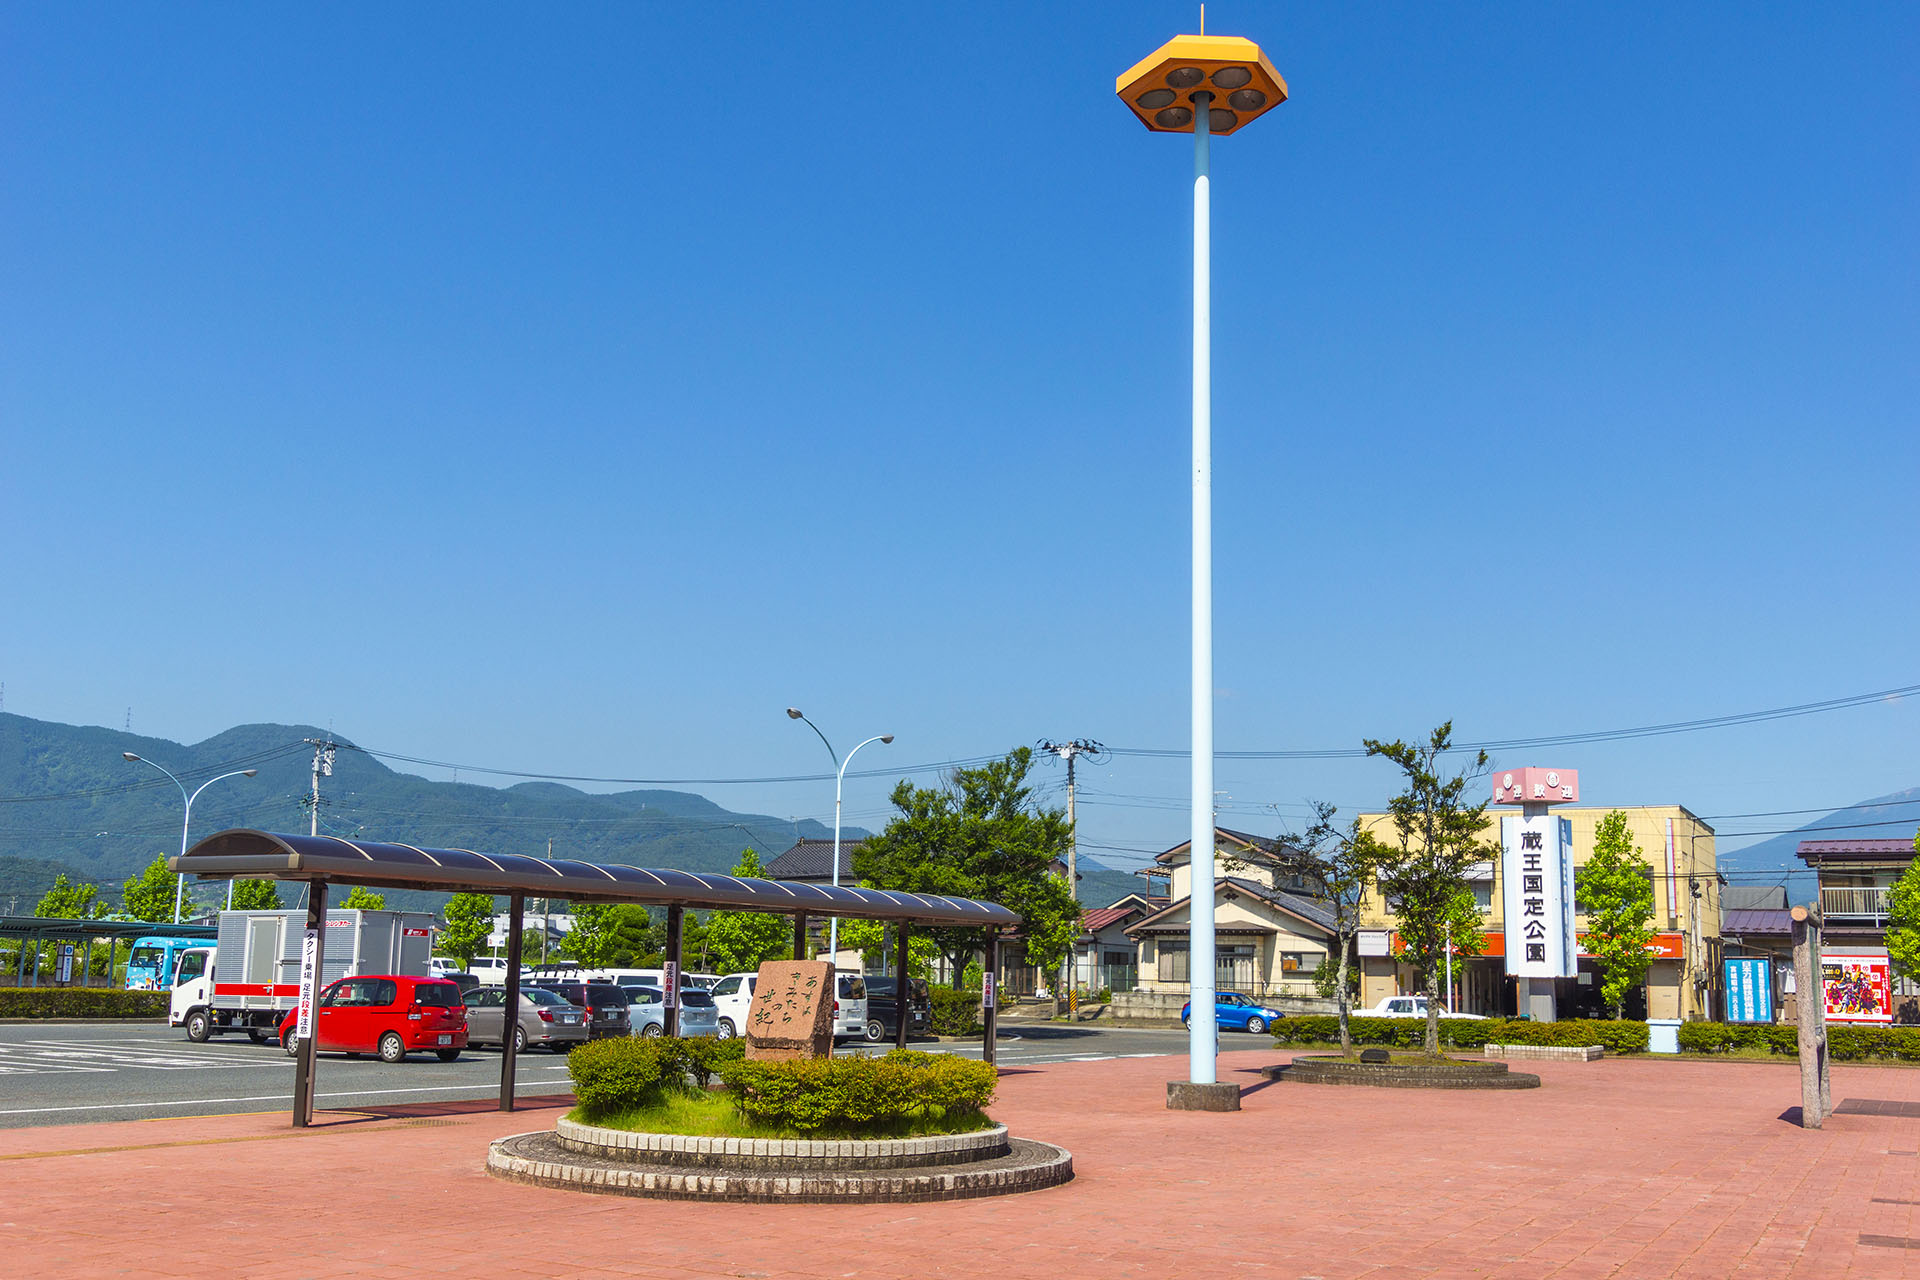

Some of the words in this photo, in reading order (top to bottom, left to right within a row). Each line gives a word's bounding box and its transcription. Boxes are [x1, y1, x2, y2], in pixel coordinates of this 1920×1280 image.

[1521, 830, 1546, 963] 蔵王国定公園
[303, 932, 315, 980] タクシー乗場
[299, 983, 311, 1035] 足元段差注意
[755, 988, 776, 1026] 世紀
[801, 975, 817, 1016] あすよ
